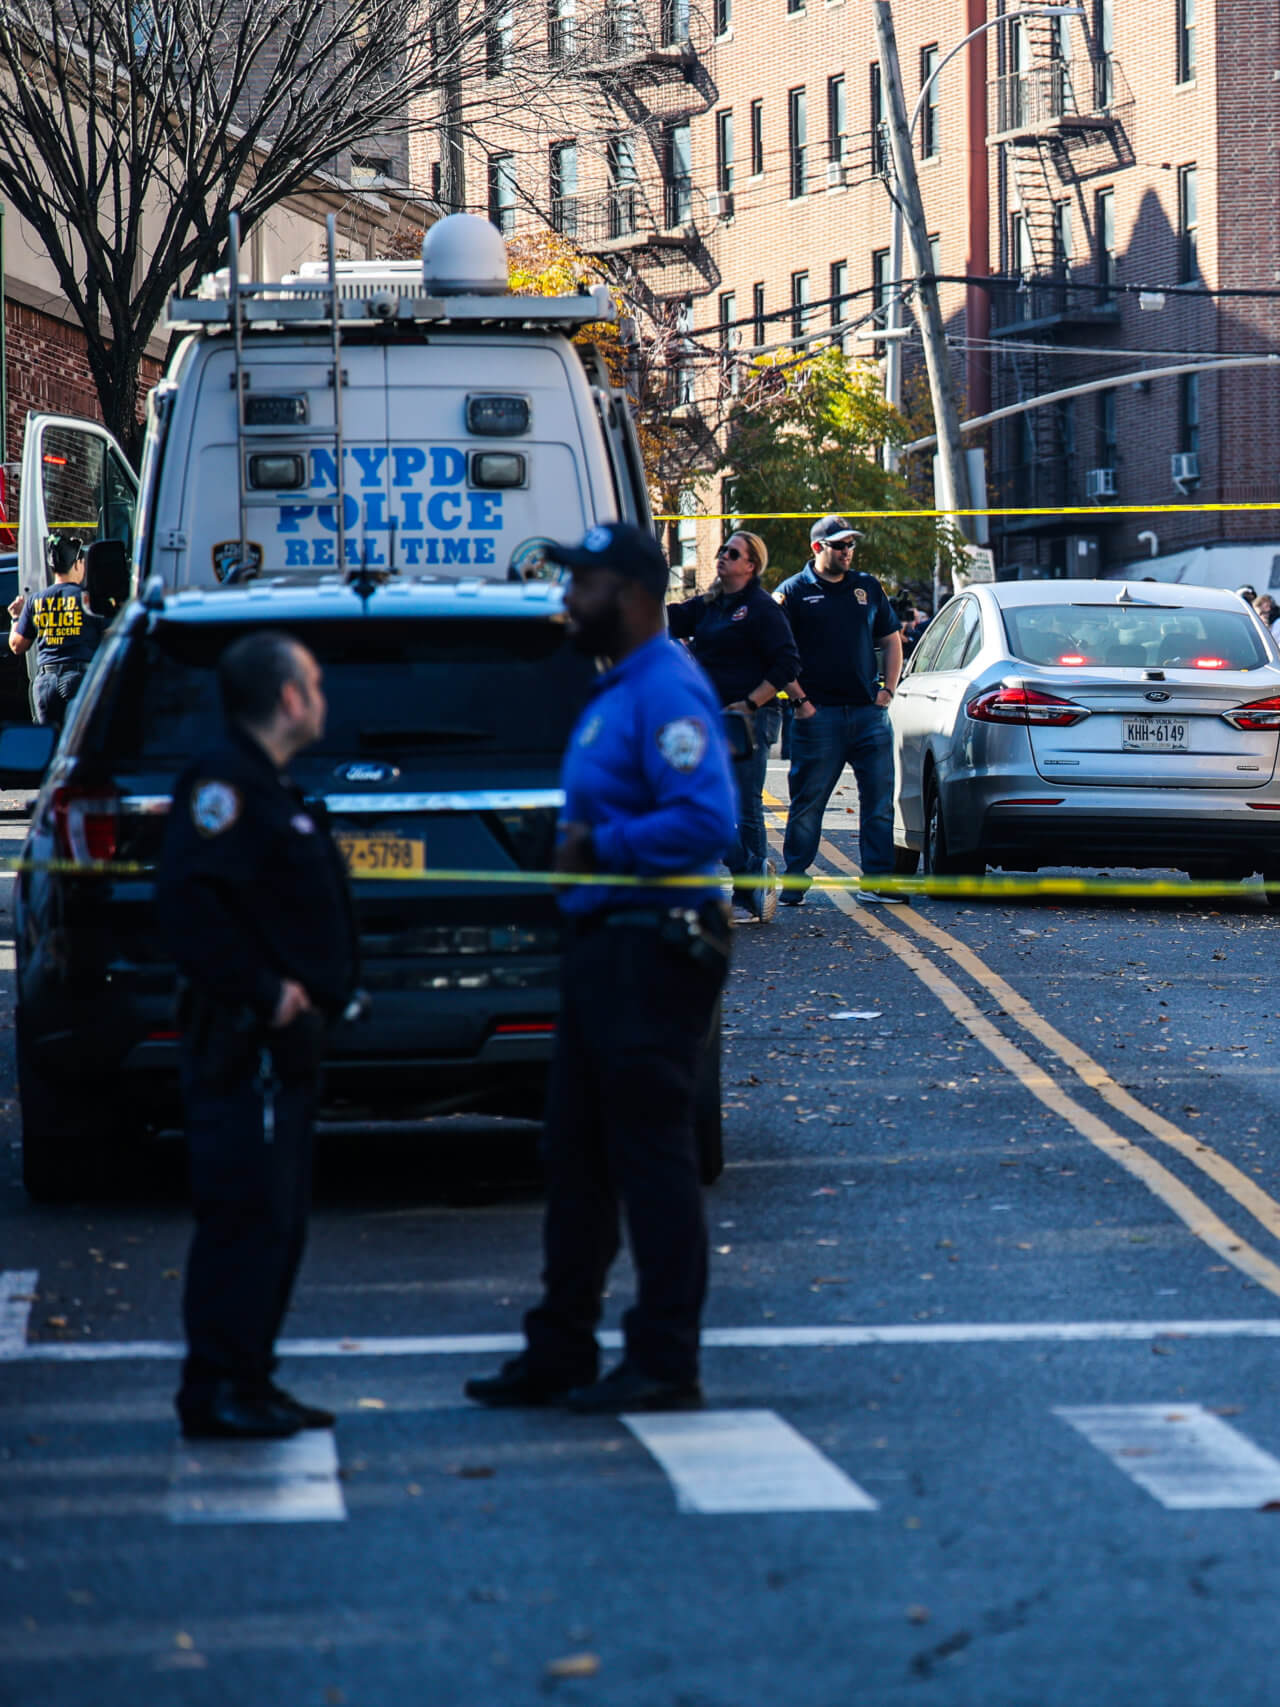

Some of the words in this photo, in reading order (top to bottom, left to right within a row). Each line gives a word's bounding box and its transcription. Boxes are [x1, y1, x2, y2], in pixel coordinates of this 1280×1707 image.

[310, 447, 467, 488] NYPD
[276, 492, 504, 533] POLICE
[284, 538, 386, 567] REAL
[401, 537, 496, 565] TIME
[33, 611, 83, 628] POLICE
[46, 637, 65, 646] UNIT
[55, 627, 81, 636] SCENE
